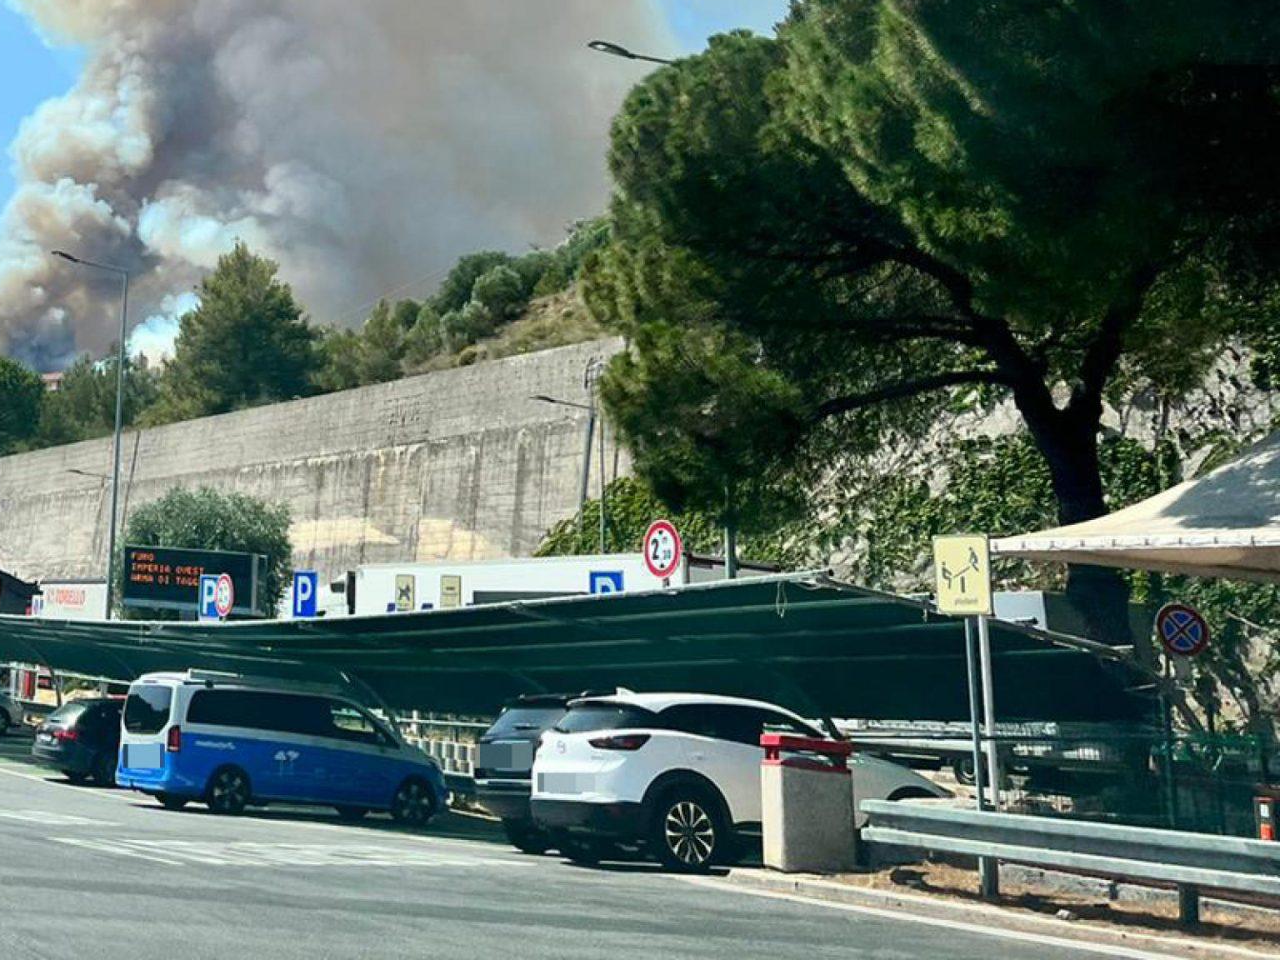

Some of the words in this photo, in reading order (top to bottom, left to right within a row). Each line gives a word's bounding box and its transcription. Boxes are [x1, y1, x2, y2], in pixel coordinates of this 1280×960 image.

[651, 539, 660, 561] 2
[132, 562, 171, 574] IMPERIA
[175, 566, 205, 575] OVEST
[158, 575, 170, 585] DI
[175, 575, 199, 587] TAGG
[202, 578, 217, 615] P
[297, 575, 312, 613] P
